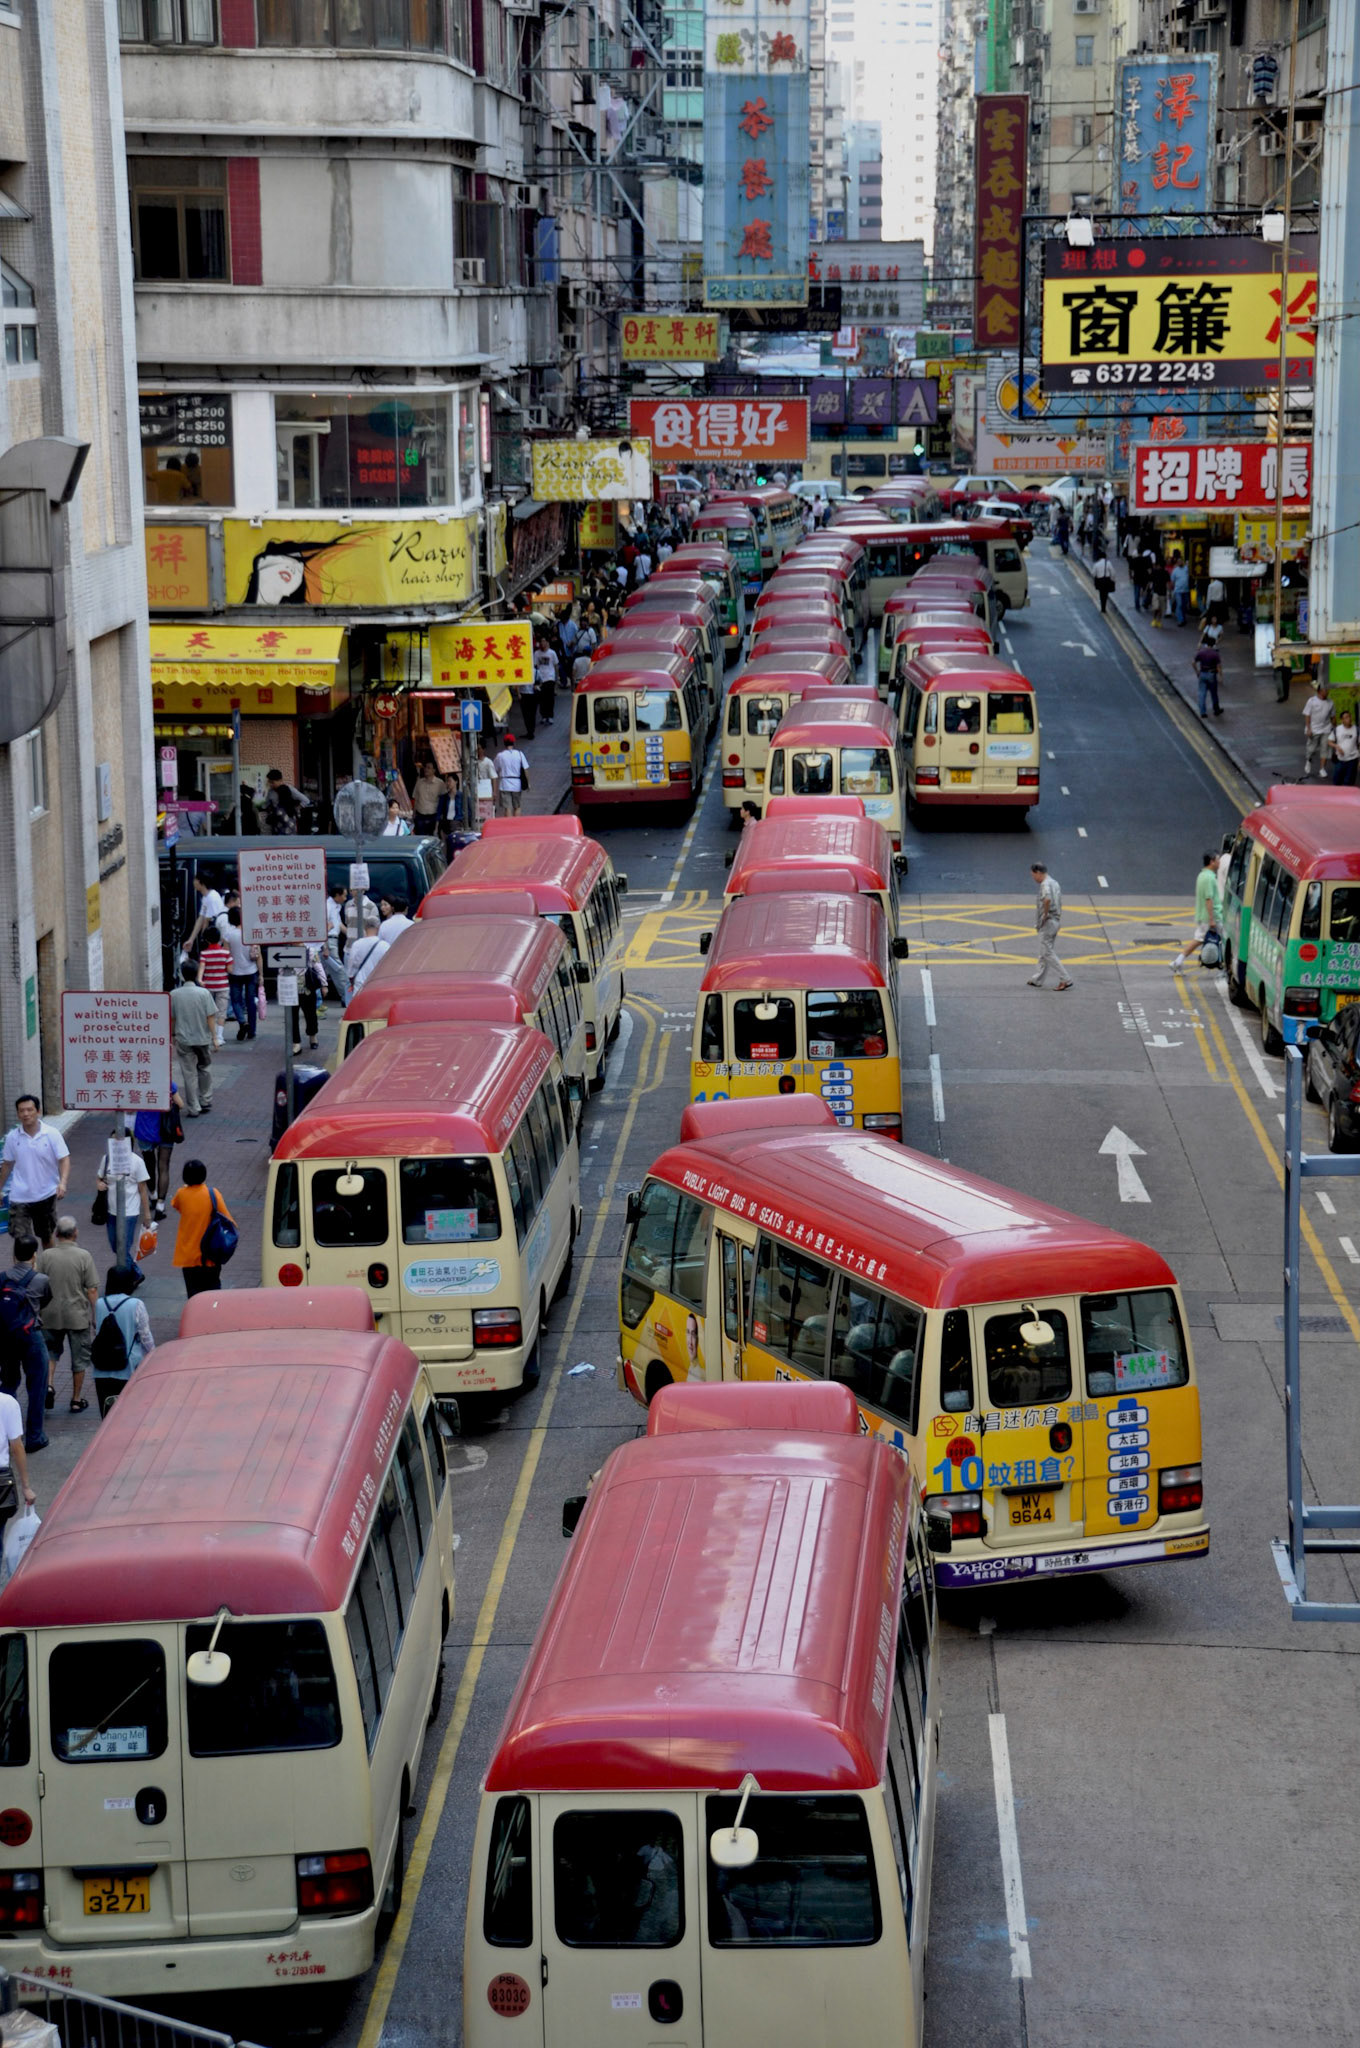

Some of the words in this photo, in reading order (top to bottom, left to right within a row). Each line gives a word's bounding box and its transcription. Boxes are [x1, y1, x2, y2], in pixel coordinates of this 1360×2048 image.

[1151, 72, 1200, 190] 澤記
[738, 96, 774, 261] 茶餐廳
[1061, 248, 1118, 271] 理想
[1062, 281, 1233, 356] 窗簾
[641, 320, 716, 345] 雲貴軒
[1095, 362, 1153, 383] 6372
[1158, 361, 1216, 382] 2243
[194, 408, 225, 419] $200
[194, 421, 226, 432] $250
[651, 403, 783, 448] 食得好
[194, 434, 226, 446] $300
[693, 447, 719, 459] Yummy
[721, 447, 743, 459] Shop
[1142, 447, 1244, 503] 招牌
[150, 533, 187, 576] 祥
[400, 568, 432, 586] hair
[435, 567, 465, 590] shop
[455, 634, 527, 662] 海天堂
[167, 666, 179, 675] Tin
[181, 667, 201, 678] Tong
[214, 667, 228, 675] Hoi
[230, 667, 242, 676] Tin
[245, 667, 265, 678] Tong
[278, 668, 292, 676] Hoi
[294, 667, 306, 676] Tin
[307, 668, 328, 679] Tong
[264, 852, 300, 862] Vehicle
[248, 863, 284, 874] waiting
[286, 863, 303, 871] will
[305, 862, 317, 871] be
[255, 871, 310, 884] prosecuted
[244, 882, 281, 892] without
[283, 881, 322, 893] warning
[257, 895, 311, 908] 停車等候
[258, 910, 312, 923] 會被檢控
[251, 926, 318, 940] 而不予警告
[95, 997, 139, 1008] Vehicle
[73, 1009, 118, 1022] waiting
[121, 1009, 142, 1019] will
[145, 1009, 160, 1019] be
[83, 1022, 150, 1034] prosecuted
[68, 1034, 115, 1045] without
[118, 1034, 165, 1048] warning
[84, 1049, 152, 1064] 停車等候
[714, 1062, 785, 1077] 時昌迷你倉
[85, 1069, 152, 1084] 會被檢控
[76, 1089, 160, 1104] 而不予警告
[829, 1086, 845, 1095] 太古
[682, 1170, 706, 1192] PUBLIC
[707, 1183, 729, 1203] LIGHT
[730, 1193, 746, 1212] BUS
[746, 1202, 756, 1217] 16
[759, 1207, 784, 1229] SEATS
[786, 1220, 887, 1281] 公共小型巴士十六座位
[428, 1275, 467, 1284] COASTER
[404, 1325, 470, 1336] COASTER
[963, 1406, 1059, 1434] 時昌迷你倉
[1117, 1411, 1138, 1423] 柴灣
[1118, 1433, 1139, 1445] 太古
[1118, 1456, 1140, 1468] 北角
[1118, 1478, 1139, 1490] 西環
[1021, 1494, 1042, 1509] MV
[1113, 1498, 1144, 1511] 香港仔
[1011, 1508, 1053, 1524] 9644
[88, 1894, 146, 1913] 3271
[498, 1975, 519, 1986] PSL
[491, 1988, 527, 2003] 8303C
